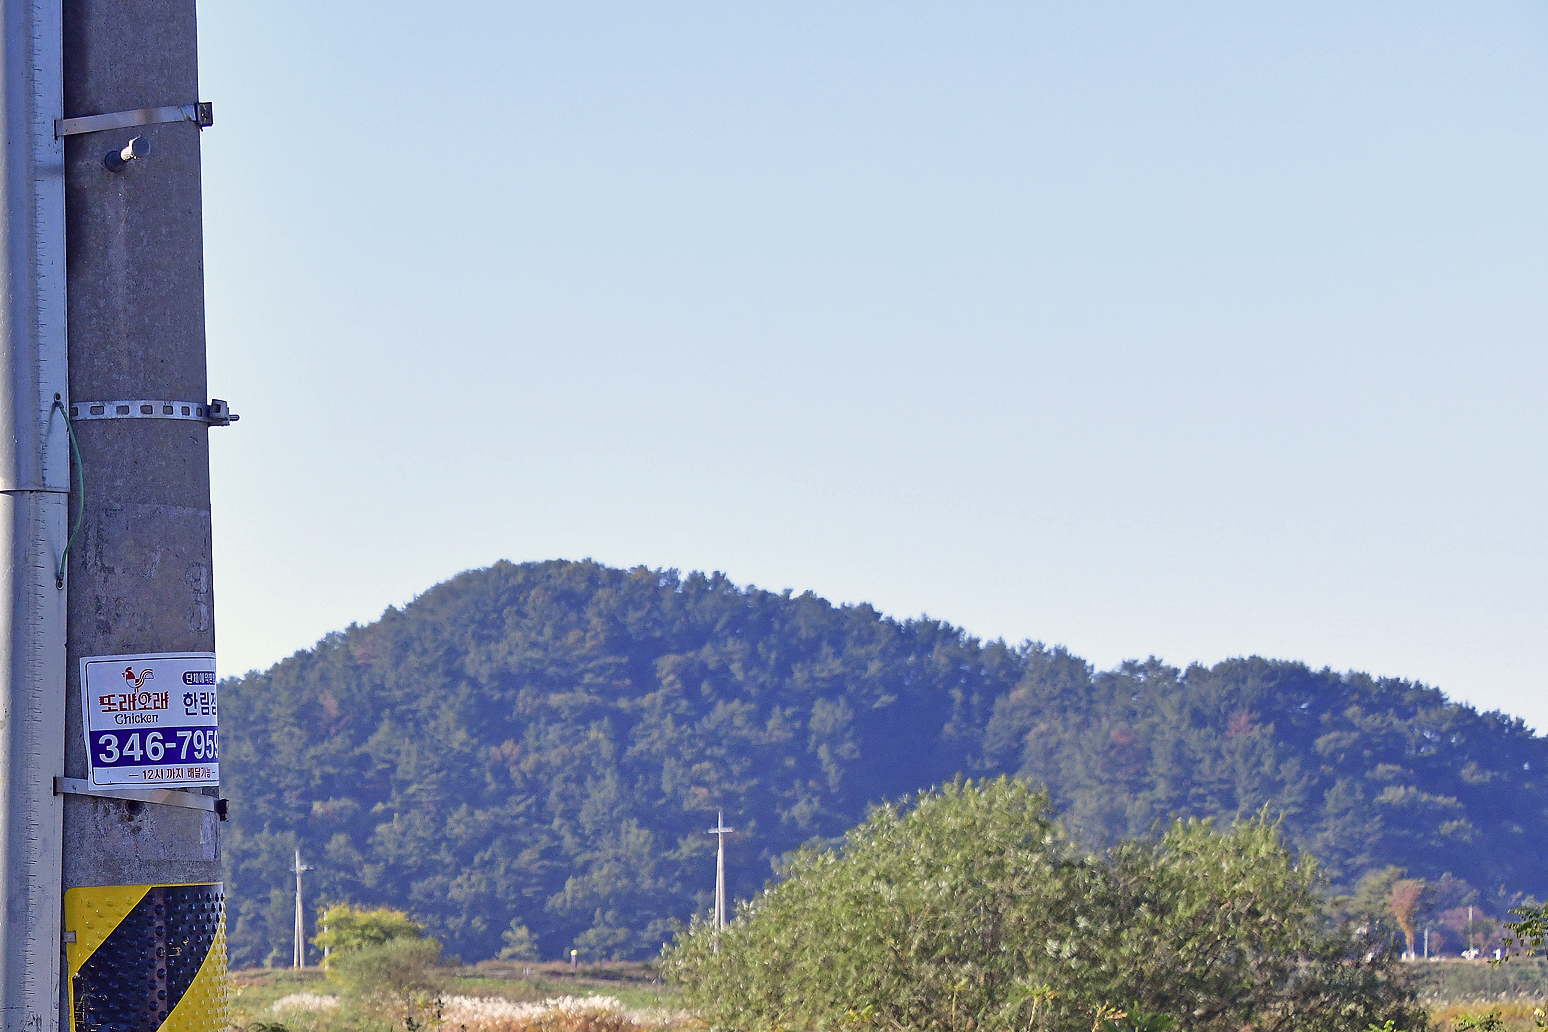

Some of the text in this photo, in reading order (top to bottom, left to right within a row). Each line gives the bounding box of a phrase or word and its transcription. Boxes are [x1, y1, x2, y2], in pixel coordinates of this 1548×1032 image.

[99, 691, 169, 712] 또래오래
[114, 713, 158, 725] Chicken
[142, 768, 164, 780] 12시
